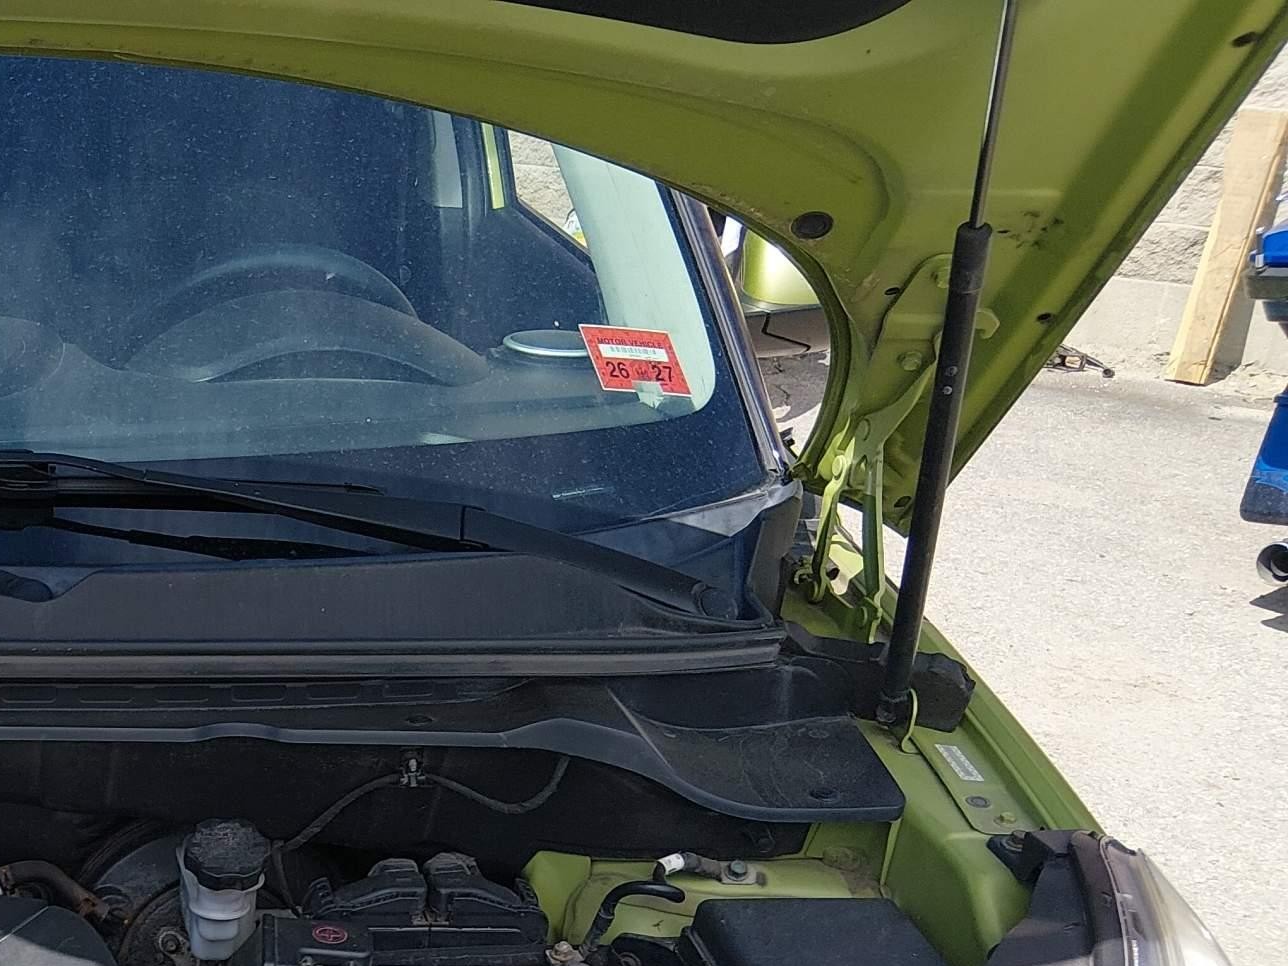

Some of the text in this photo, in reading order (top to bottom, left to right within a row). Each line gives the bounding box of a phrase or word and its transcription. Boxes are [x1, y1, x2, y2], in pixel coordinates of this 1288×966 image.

[597, 337, 664, 349] MOTOR VEHICLE
[605, 361, 673, 382] 26 27
